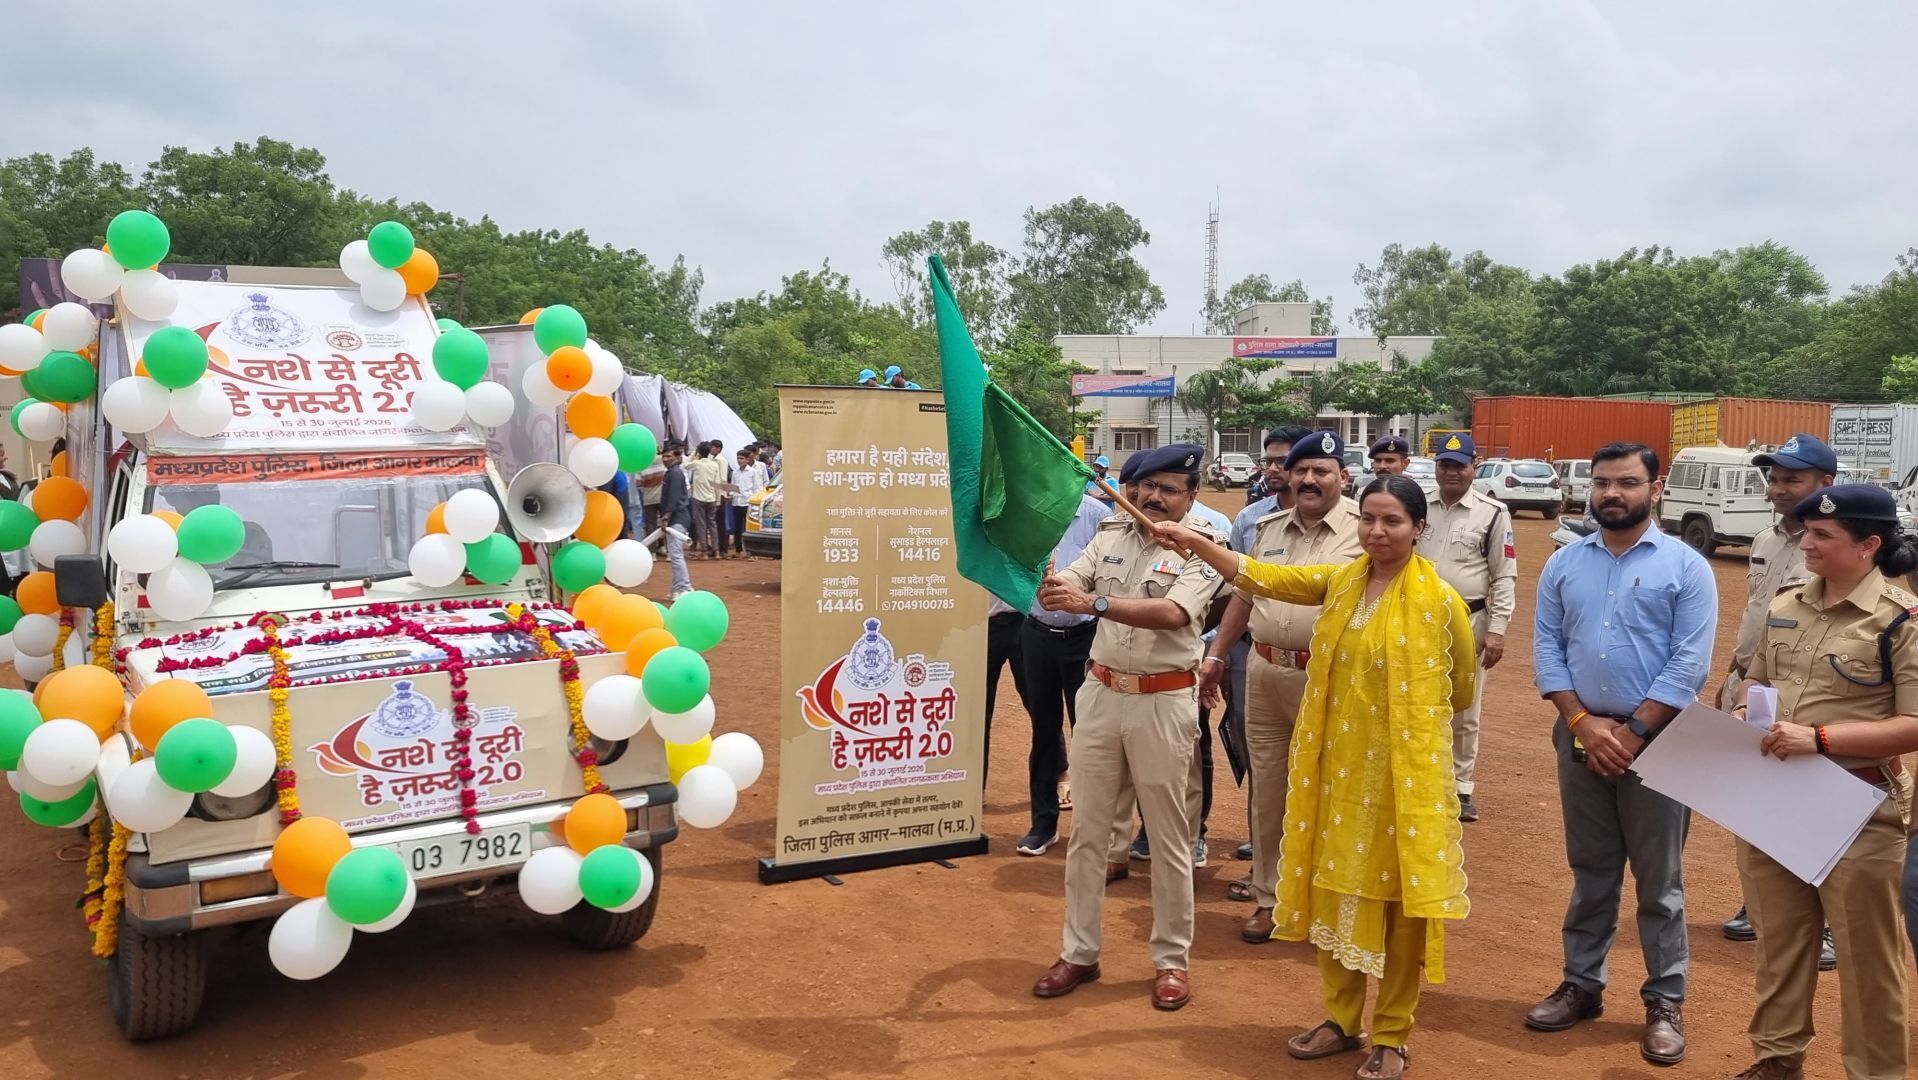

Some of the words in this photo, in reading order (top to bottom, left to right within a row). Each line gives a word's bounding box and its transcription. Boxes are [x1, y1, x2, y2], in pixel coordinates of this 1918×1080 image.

[237, 354, 311, 381] नशे
[318, 354, 360, 381] से
[361, 353, 423, 390] दूरी
[221, 382, 252, 417] है
[257, 383, 362, 418] ज़रूरी
[373, 391, 415, 413] 2.
[296, 418, 306, 427] से
[309, 419, 324, 427] 30
[262, 427, 296, 440] पुलिस
[826, 449, 866, 466] हमारा
[869, 445, 879, 466] है
[882, 446, 909, 468] यही
[154, 455, 247, 477] मध्यप्रदेश
[813, 470, 876, 491] नशा-मुक्त
[879, 467, 894, 488] हो
[898, 471, 926, 488] मध्य
[830, 527, 852, 536] मानस
[907, 525, 932, 536] नेशनल
[823, 536, 859, 547] हेल्पलाइन
[889, 537, 915, 549] सुसाइड
[915, 536, 949, 547] हेल्पलाइन
[823, 548, 859, 562] 1933
[898, 547, 941, 562] 14416
[822, 575, 859, 588] नशा-मुक्ति
[891, 576, 906, 585] मध्य
[907, 574, 924, 585] प्रदेश
[925, 573, 946, 587] पुलिस
[822, 587, 859, 598] हेल्पलाइन
[926, 586, 948, 596] विभाग
[816, 598, 864, 613] 14446
[891, 599, 954, 611] 7049100785
[848, 693, 890, 726] नशे
[894, 691, 917, 723] से
[920, 687, 956, 732] दूरी
[378, 738, 436, 768] नशे
[476, 726, 523, 763] दूरी
[833, 731, 849, 769] है
[853, 727, 914, 767] ज़रूरी
[918, 732, 952, 758] 2.0
[878, 768, 887, 777] 30
[361, 775, 383, 805] है
[477, 761, 523, 787] 2.0
[784, 834, 816, 854] जिला
[819, 829, 855, 853] पुलिस
[937, 815, 975, 838] (म.प्र.)
[412, 845, 443, 872] 03
[460, 831, 522, 866] 7982
